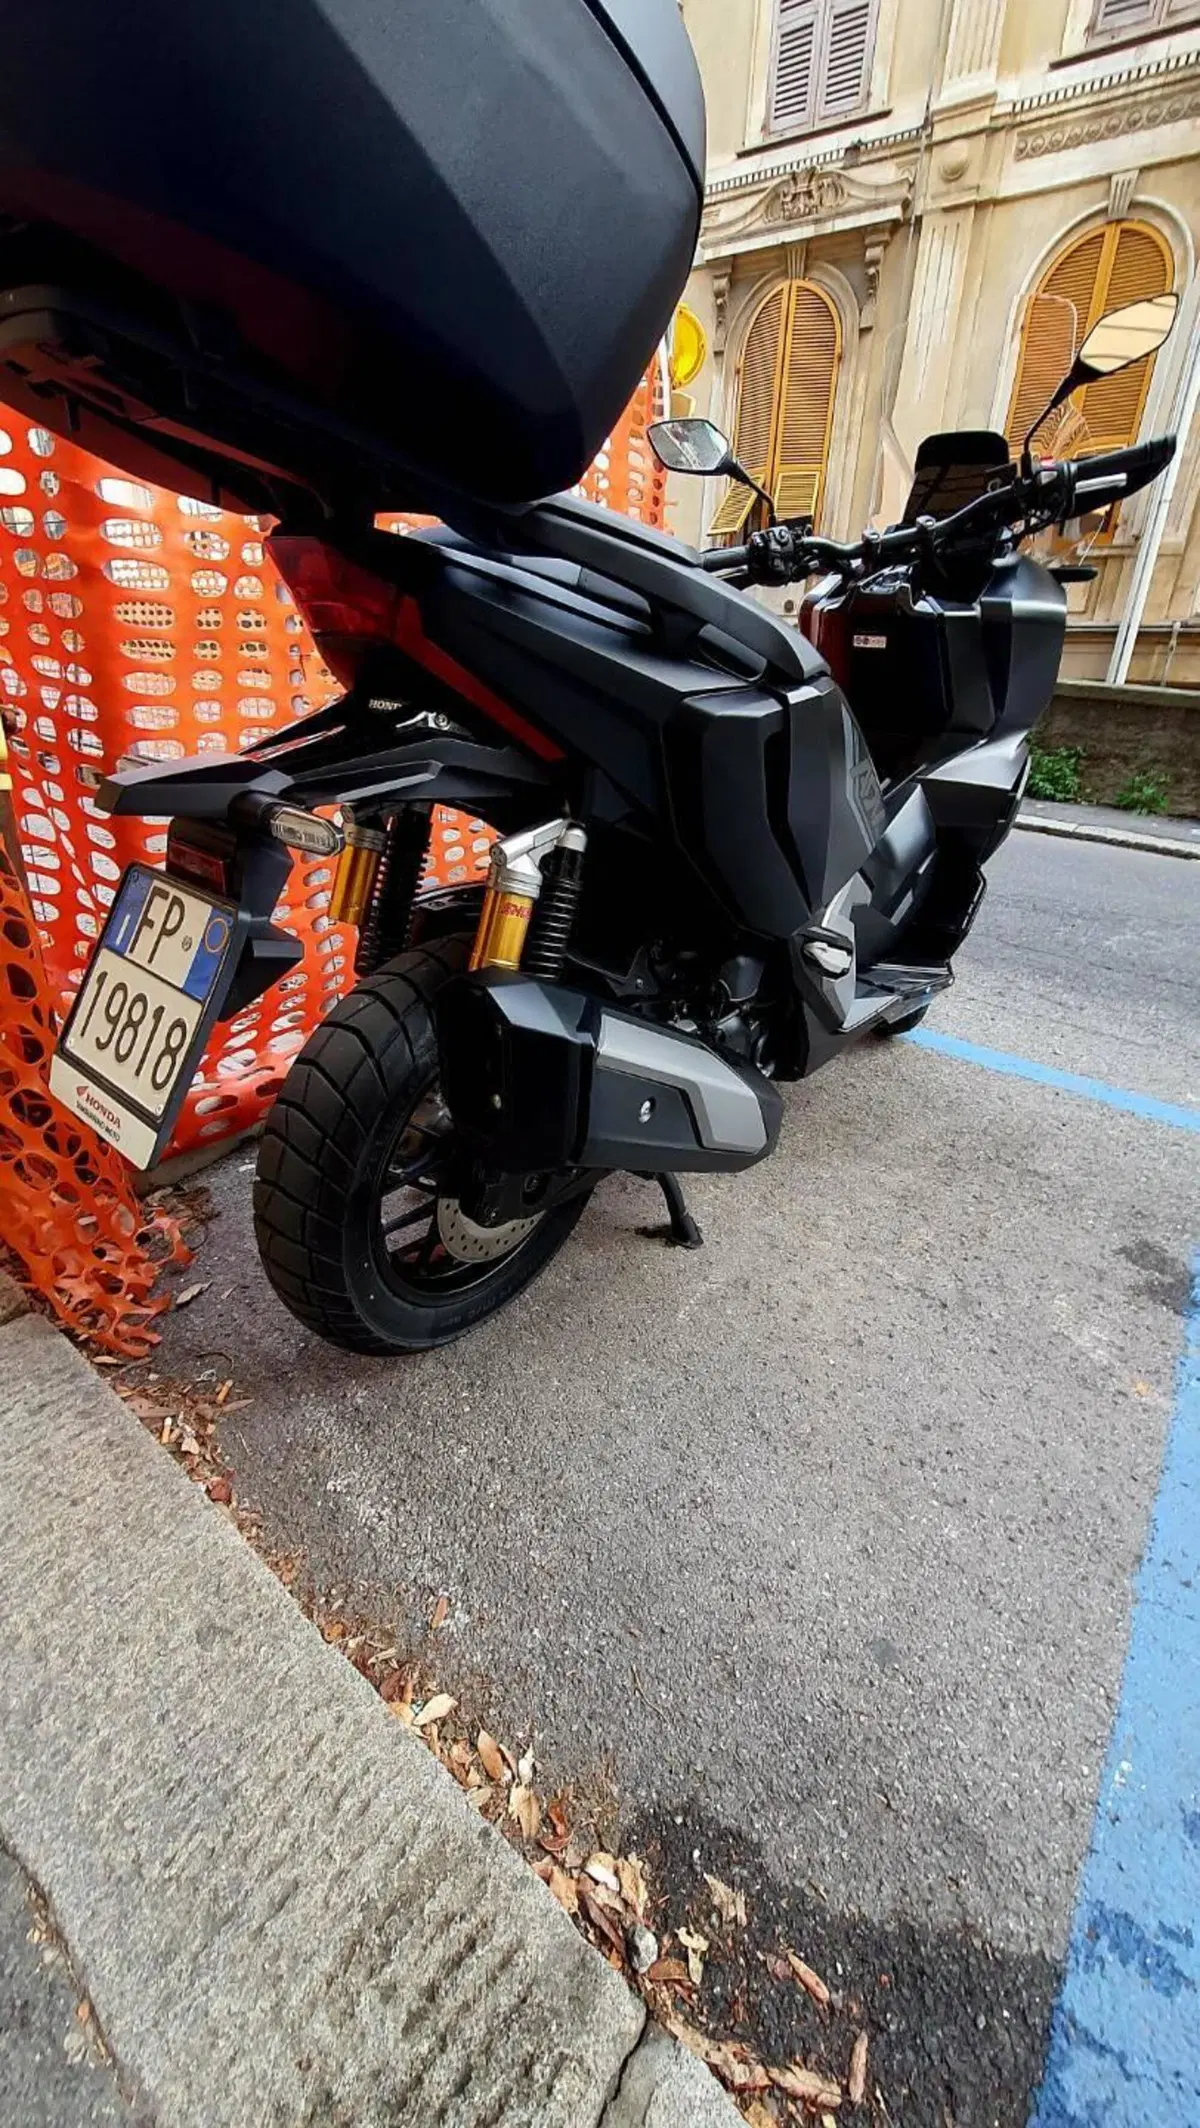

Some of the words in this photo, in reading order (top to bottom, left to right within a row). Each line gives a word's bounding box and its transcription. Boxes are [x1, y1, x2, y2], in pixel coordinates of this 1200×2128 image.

[129, 885, 186, 965] FP
[80, 970, 188, 1092] 19818
[85, 1092, 121, 1129] HONDA
